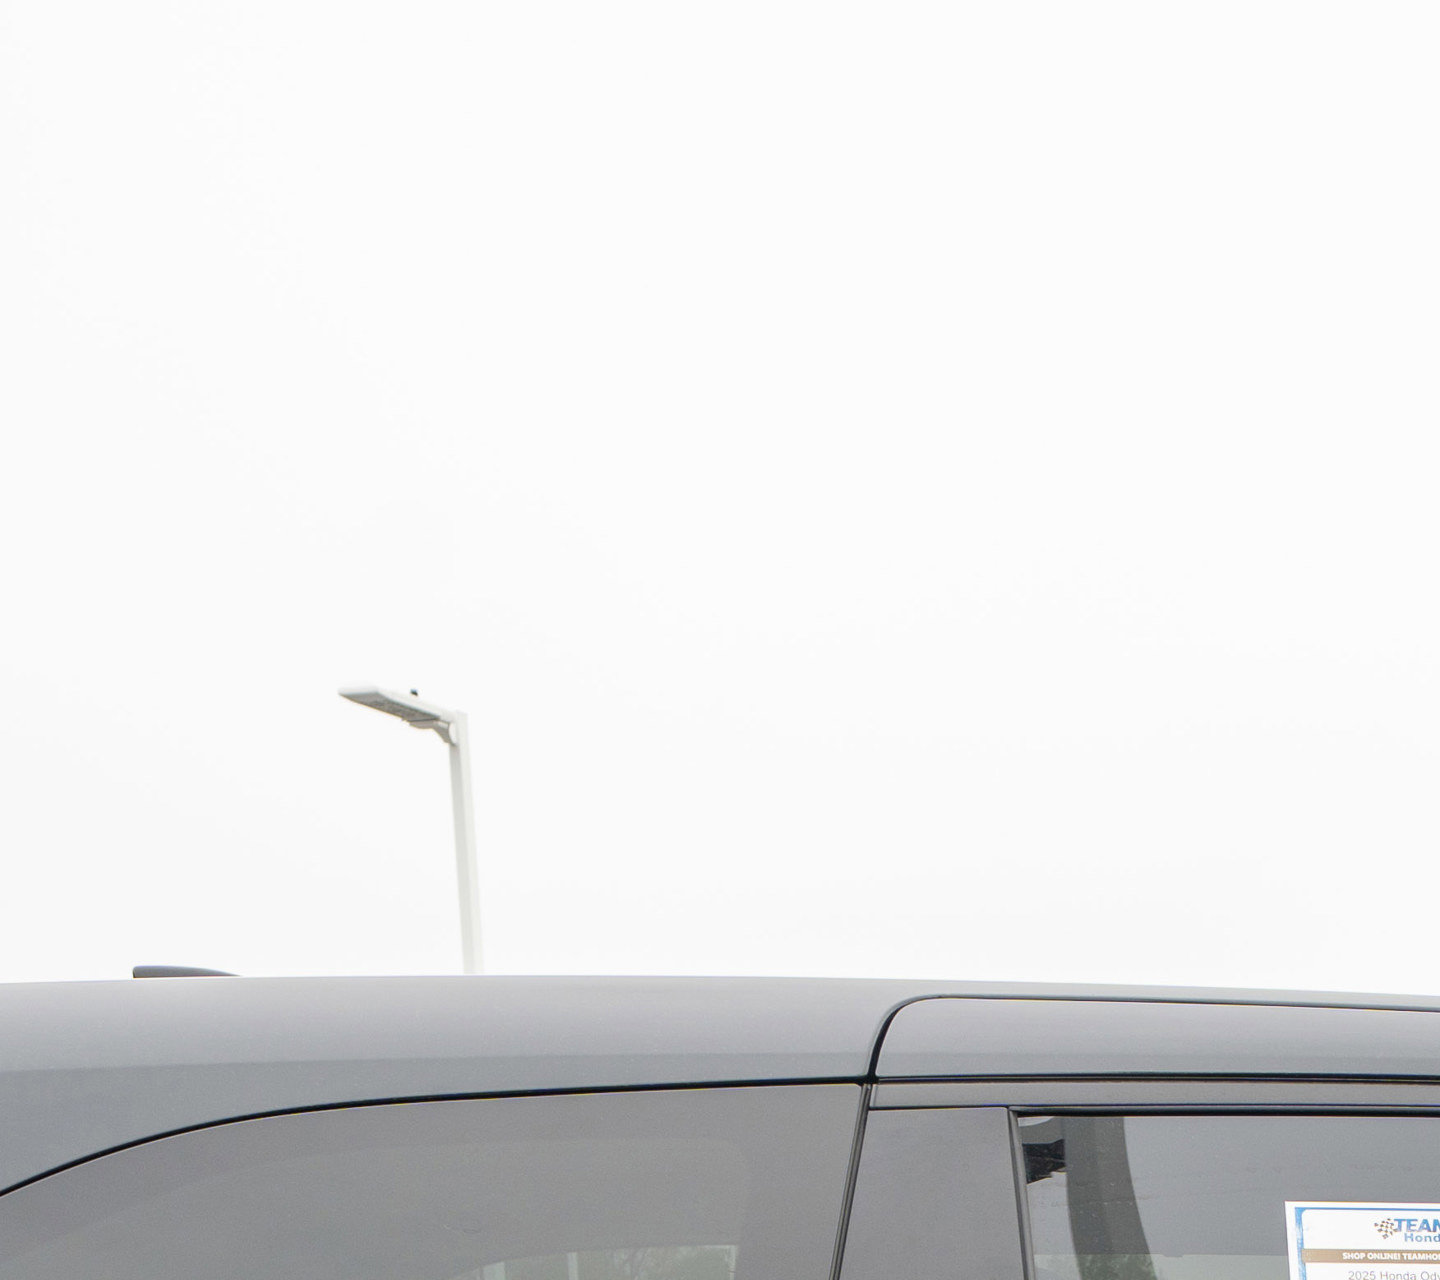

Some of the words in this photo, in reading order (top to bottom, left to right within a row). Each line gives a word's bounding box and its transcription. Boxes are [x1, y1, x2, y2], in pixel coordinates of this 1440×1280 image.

[1342, 1252, 1366, 1260] SHOP
[1367, 1252, 1401, 1261] ONLINE!
[1348, 1271, 1376, 1280] 2025
